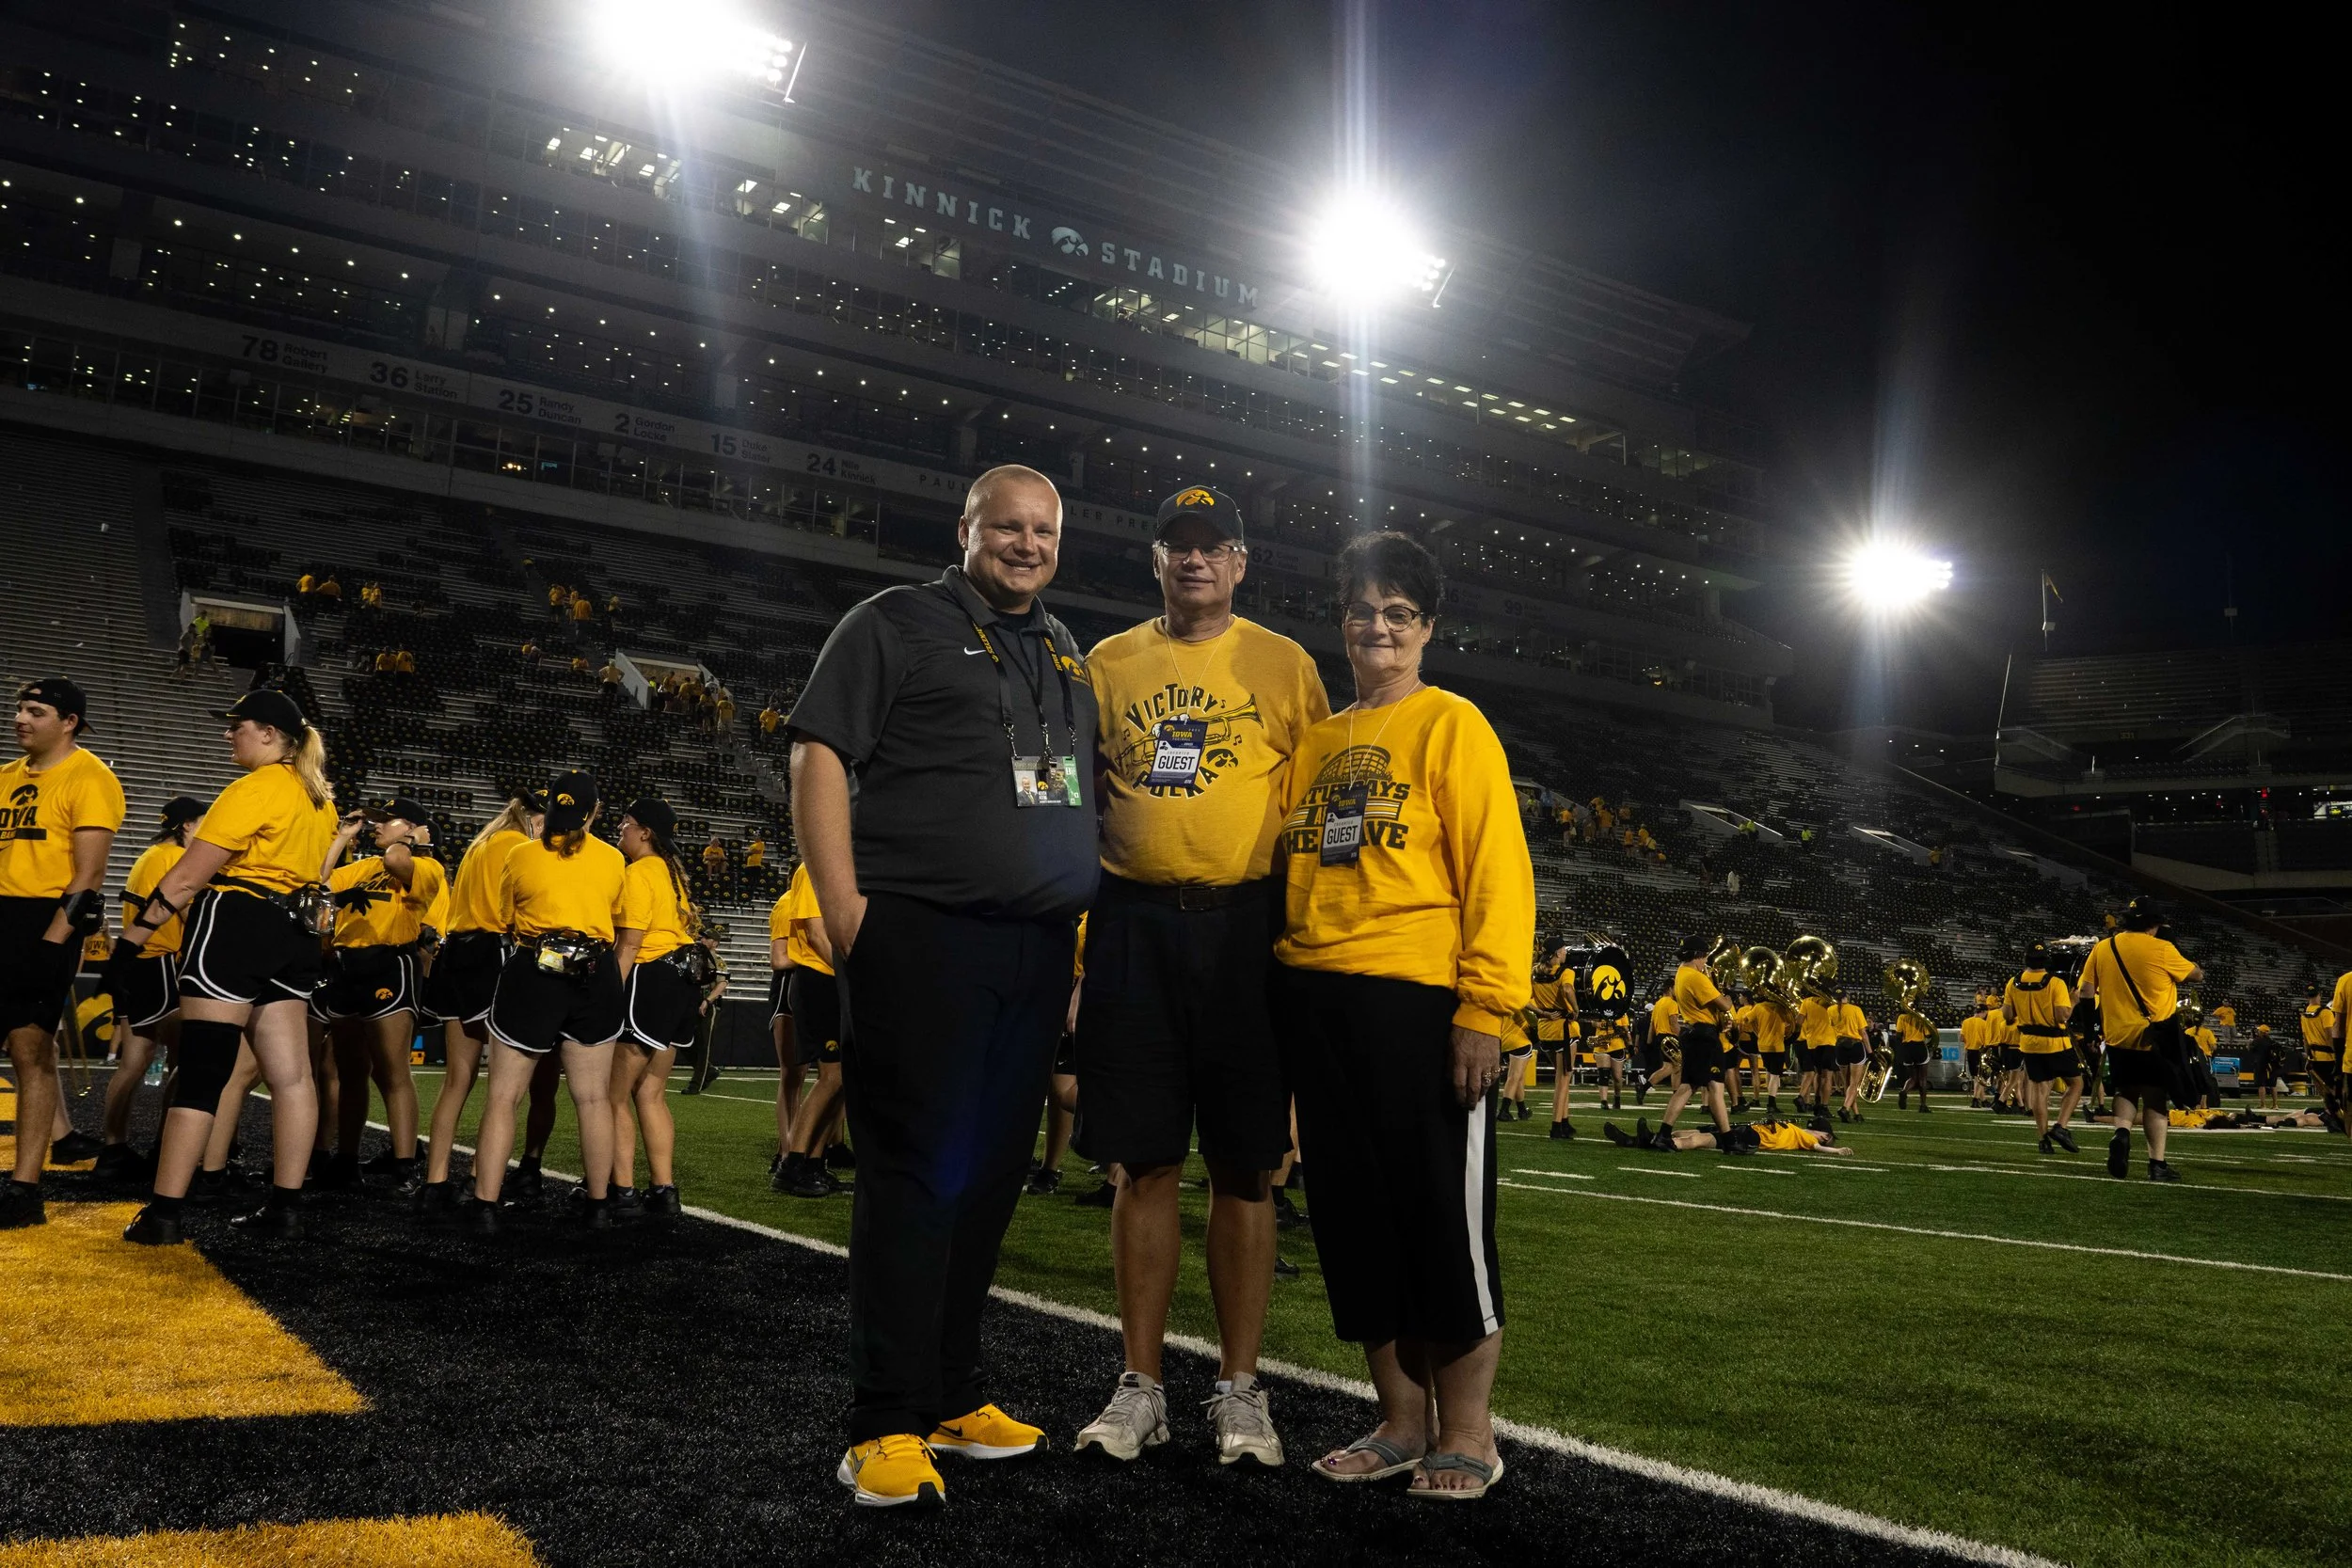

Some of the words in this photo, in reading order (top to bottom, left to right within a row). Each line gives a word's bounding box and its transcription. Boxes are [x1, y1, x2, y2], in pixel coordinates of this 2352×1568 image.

[852, 166, 1031, 241] KINNICK
[1102, 242, 1259, 308] STADIUM
[241, 334, 278, 363] 78
[283, 342, 328, 360] Robert
[282, 356, 329, 374] Gallery
[369, 361, 408, 388] 36
[414, 382, 458, 400] Station
[498, 388, 533, 415] 25
[539, 396, 575, 412] Randy
[538, 408, 581, 424] Duncan
[614, 413, 630, 435] 2
[711, 433, 737, 456] 15
[806, 452, 836, 476] 24
[1251, 546, 1273, 565] 62
[1125, 683, 1218, 734] VICTORY
[1158, 755, 1196, 770] GUEST
[1327, 825, 1359, 845] GUEST
